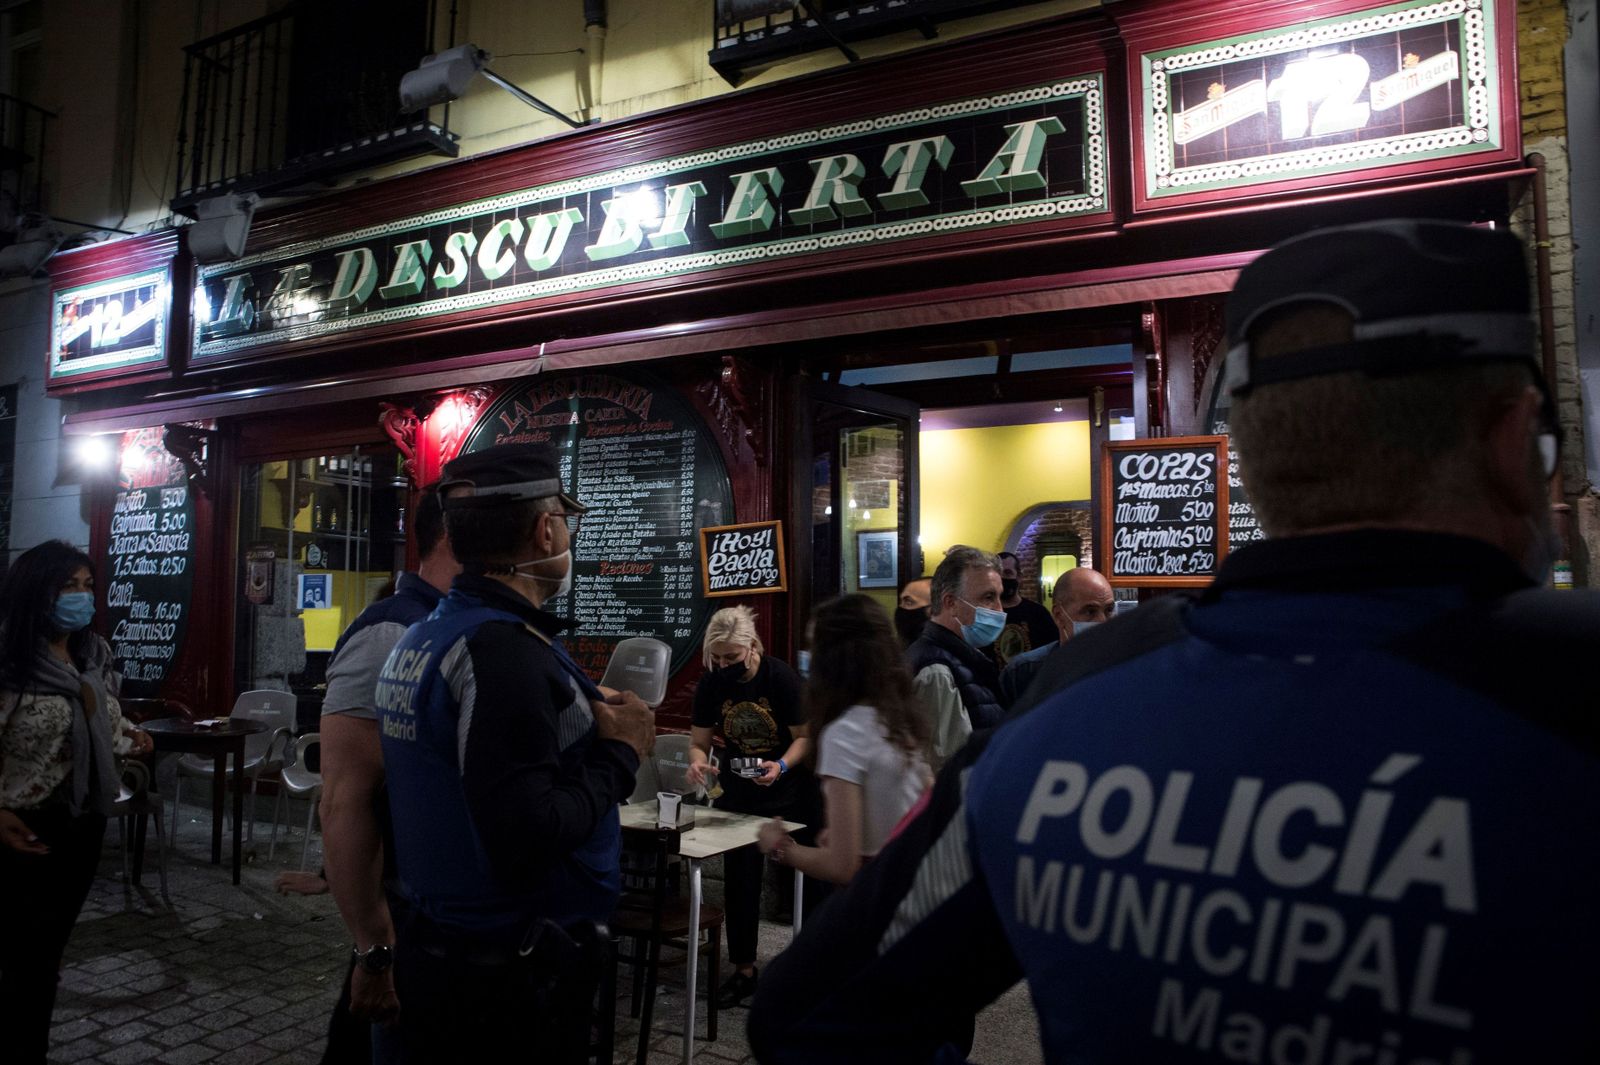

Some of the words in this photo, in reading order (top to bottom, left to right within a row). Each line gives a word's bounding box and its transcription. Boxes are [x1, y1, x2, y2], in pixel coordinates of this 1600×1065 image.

[1267, 51, 1371, 141] 12
[209, 262, 322, 337] LA
[328, 116, 1067, 309] DESCUBIERTA
[88, 299, 124, 348] 12
[499, 400, 536, 434] LA
[114, 490, 147, 513] Mojito
[1138, 482, 1189, 499] Marcas
[1115, 502, 1160, 524] Mojito
[108, 534, 139, 555] Jarra
[145, 531, 190, 553] Sangria
[113, 556, 134, 578] 1,5
[131, 555, 159, 575] Litros
[708, 548, 775, 575] Paella
[1114, 551, 1158, 574] Mojito
[710, 571, 750, 589] mixta
[107, 581, 134, 607] Cava
[111, 619, 176, 641] Lambrusco
[383, 714, 417, 742] Madrid
[1015, 753, 1479, 915] POLICÍA
[1015, 855, 1475, 1030] MUNICIPAL
